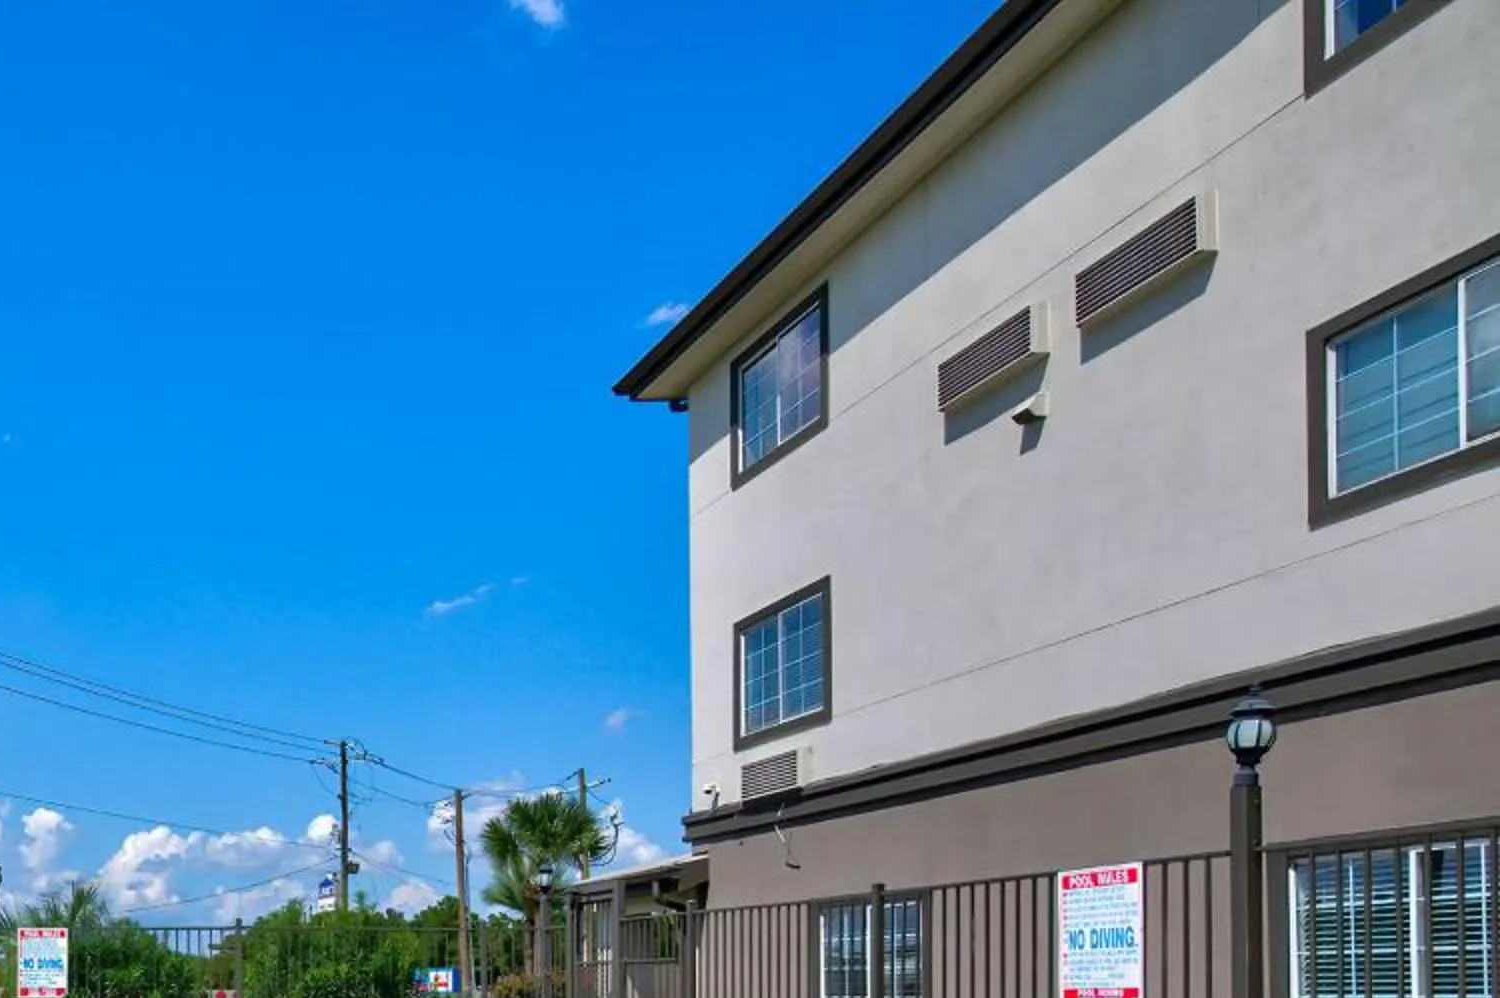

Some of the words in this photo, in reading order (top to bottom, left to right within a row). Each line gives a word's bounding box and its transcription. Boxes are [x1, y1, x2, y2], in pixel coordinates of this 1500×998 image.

[1069, 872, 1094, 889] POOL
[1097, 868, 1128, 886] RULES
[1068, 928, 1085, 950] NO
